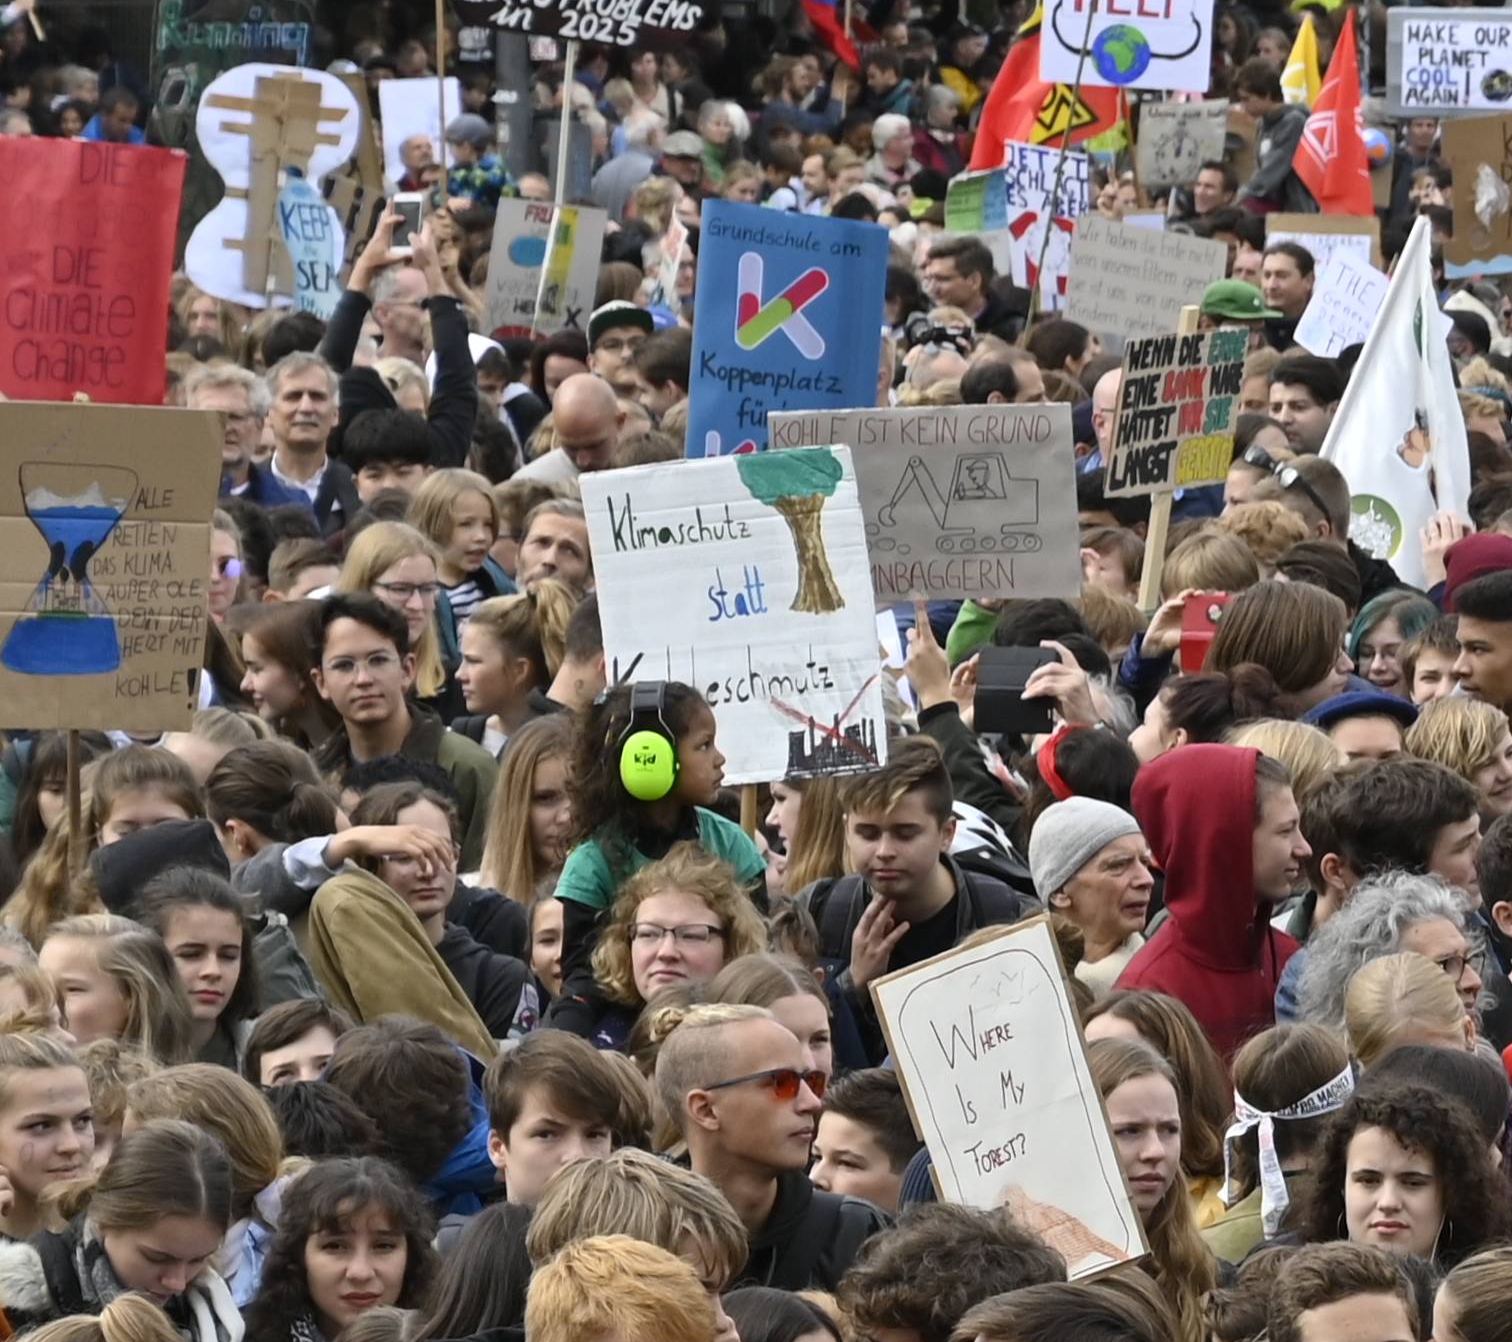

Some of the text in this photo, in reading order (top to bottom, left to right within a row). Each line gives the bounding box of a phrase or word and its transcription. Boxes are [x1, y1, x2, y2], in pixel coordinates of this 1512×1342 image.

[491, 3, 638, 46] in 2025
[1408, 24, 1511, 47] MAKE OUR
[1418, 48, 1489, 69] PLANET
[1406, 67, 1458, 85] COOL
[607, 491, 754, 553] Klimaschutz
[707, 565, 769, 623] statt
